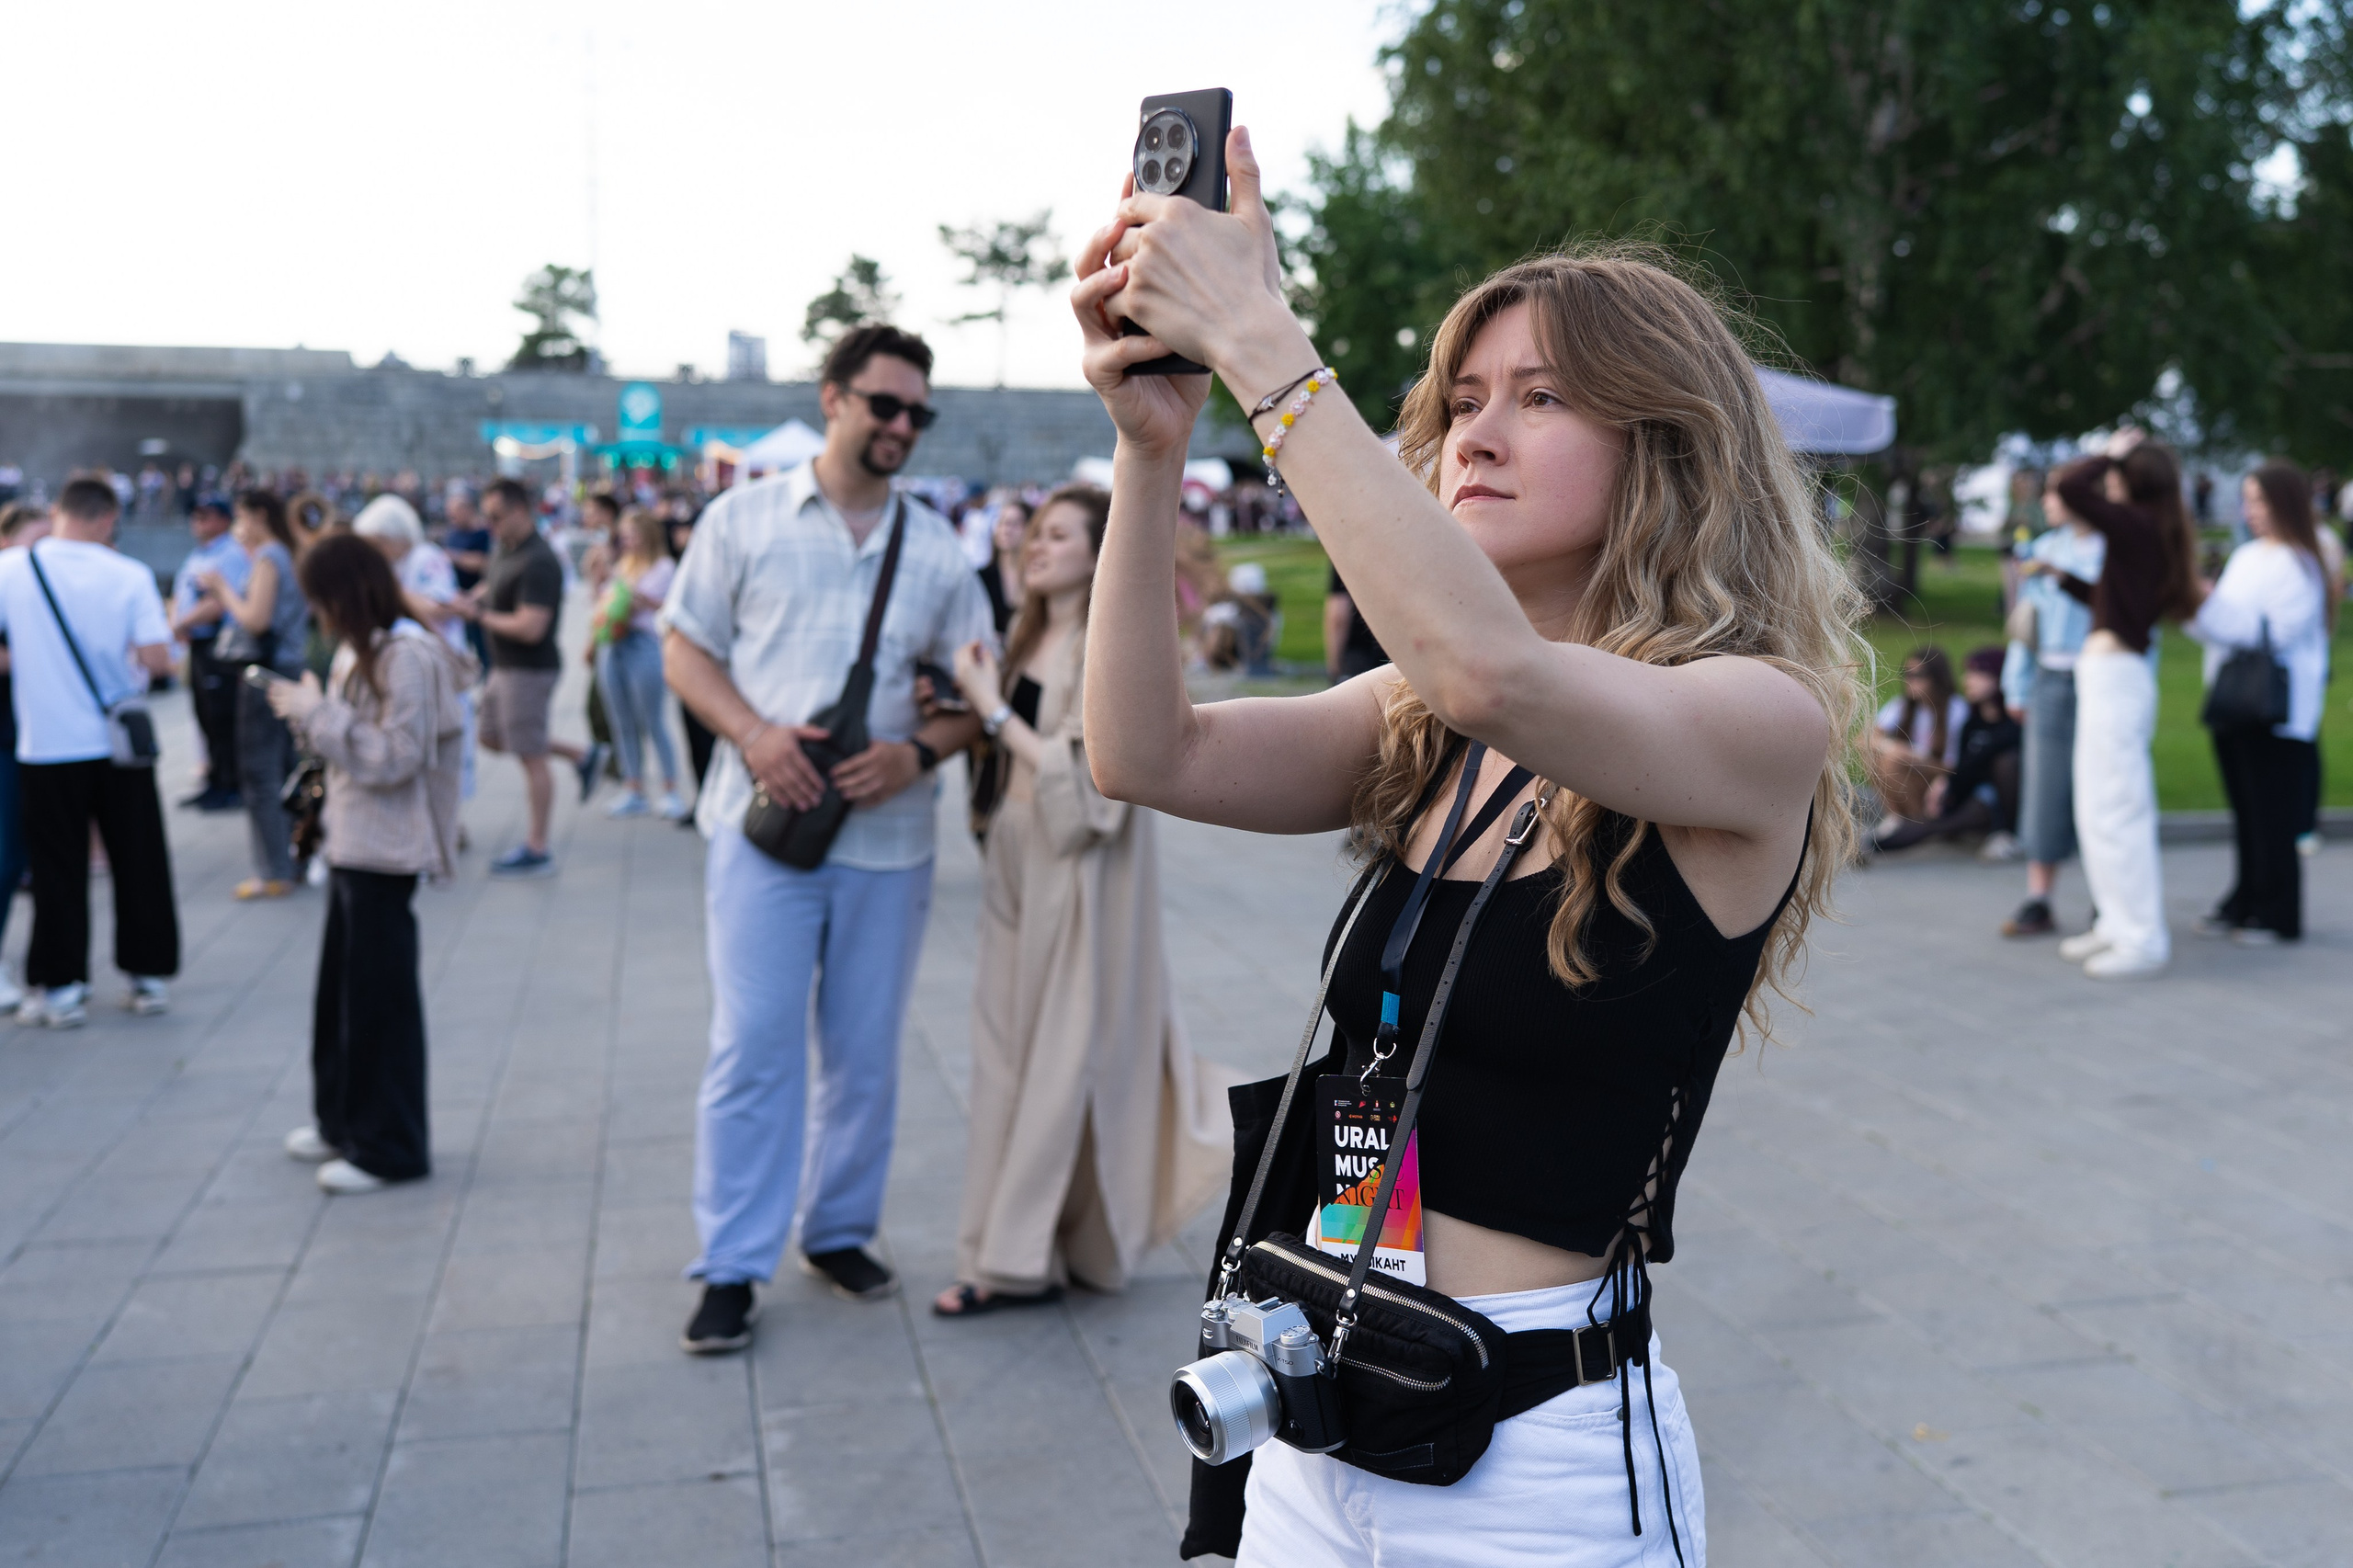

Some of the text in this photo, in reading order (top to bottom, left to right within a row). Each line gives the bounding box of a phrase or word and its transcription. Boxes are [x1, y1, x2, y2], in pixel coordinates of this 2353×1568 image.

[1335, 1125, 1390, 1150] URAL
[1335, 1154, 1404, 1182] MUS
[1336, 1183, 1405, 1210] NIGT
[1340, 1253, 1406, 1272] МУЫКАНТ
[1235, 1335, 1259, 1352] FUJIFILM
